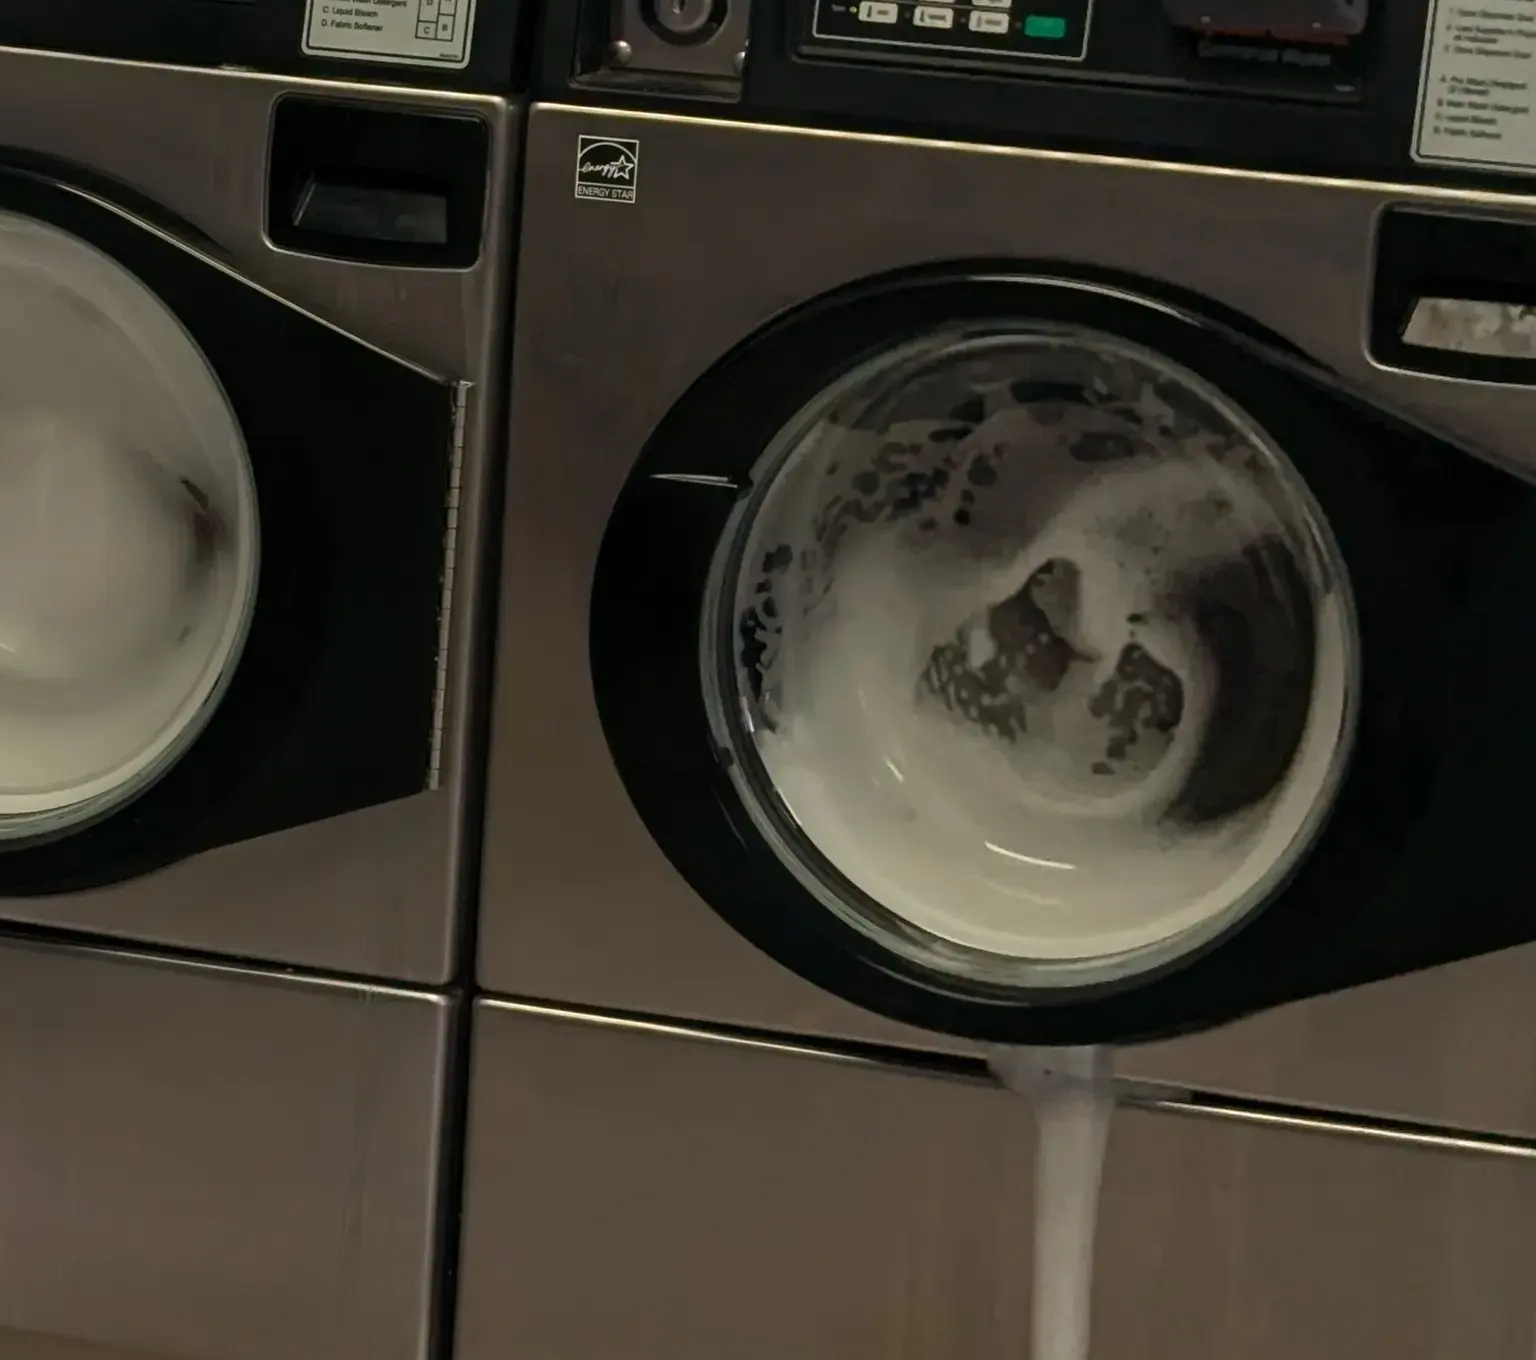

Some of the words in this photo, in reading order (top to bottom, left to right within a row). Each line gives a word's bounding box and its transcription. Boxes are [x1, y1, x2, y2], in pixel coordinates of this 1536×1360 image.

[332, 6, 353, 16] Liquid
[354, 7, 378, 17] Bleach
[321, 18, 329, 27] D.
[330, 19, 353, 29] Fabric
[354, 20, 383, 32] Softener
[423, 26, 431, 35] C
[441, 23, 448, 32] B
[578, 186, 611, 197] ENERGY
[611, 188, 633, 199] STAR
